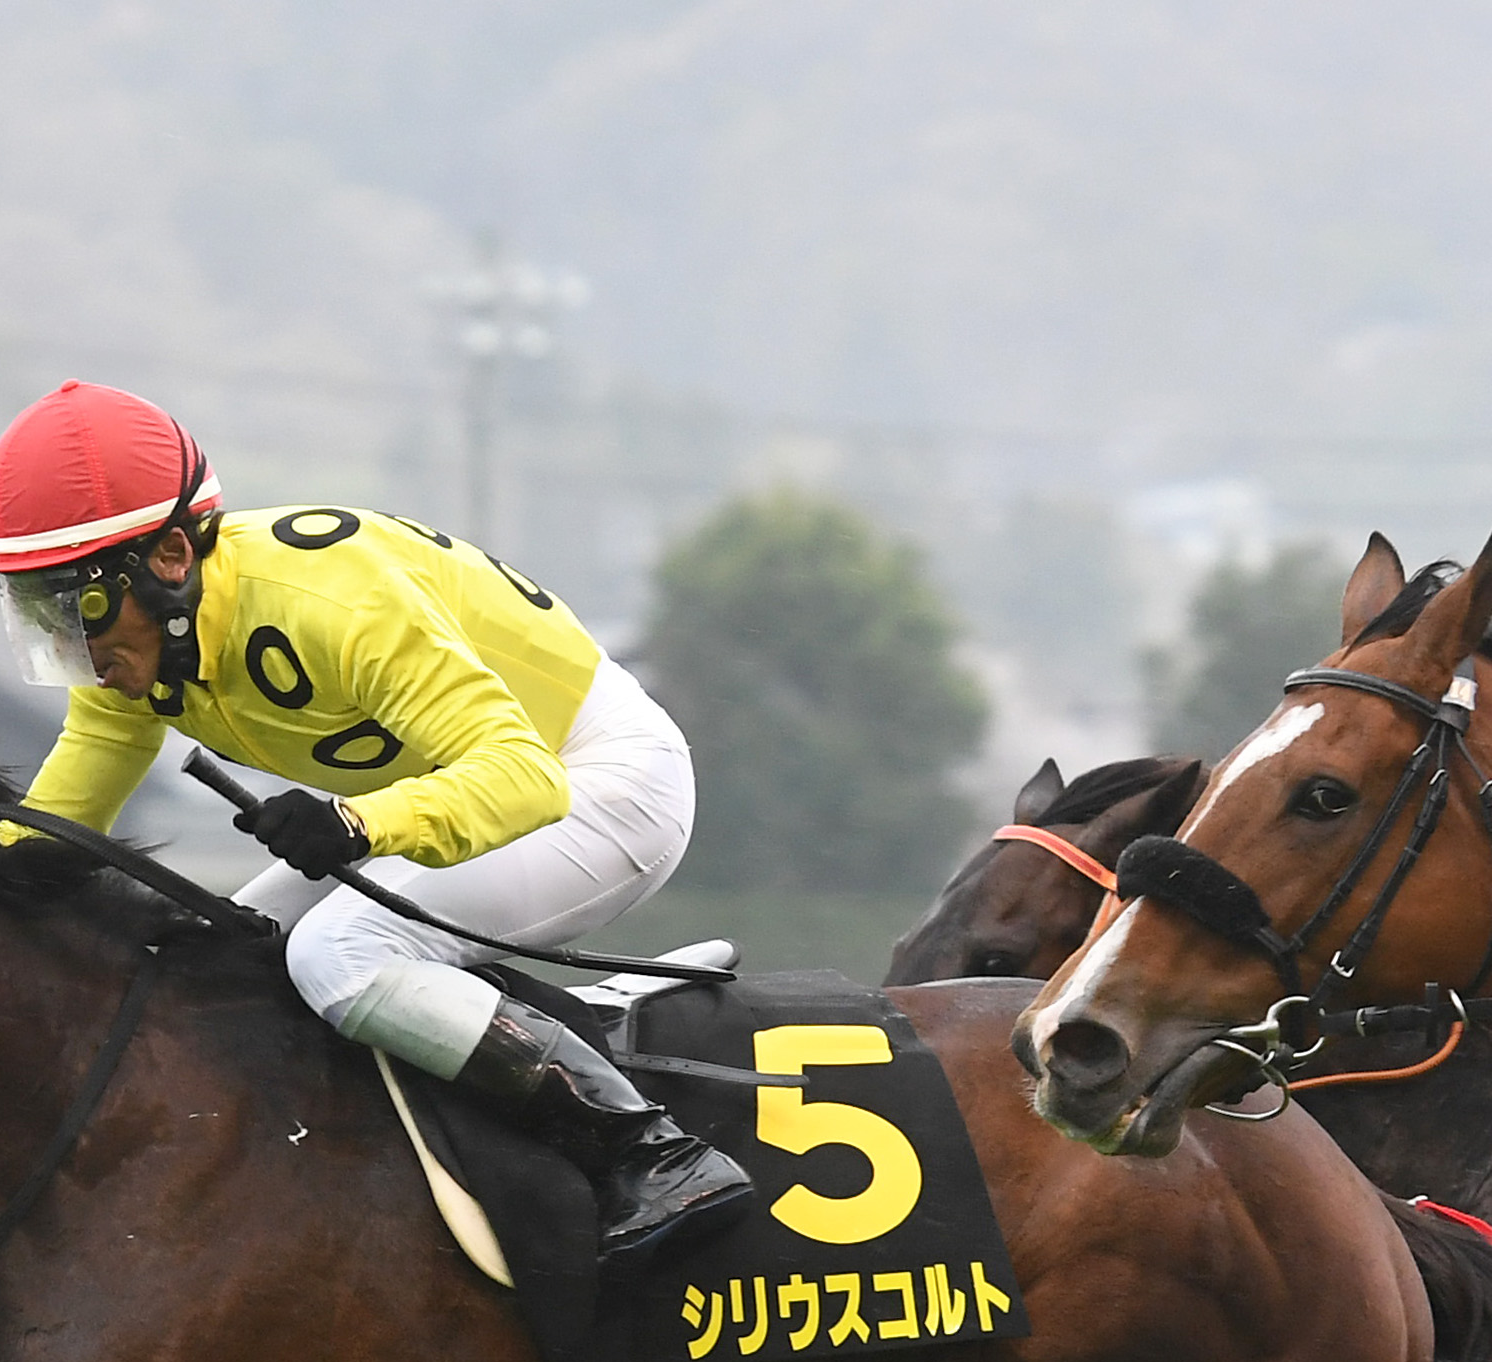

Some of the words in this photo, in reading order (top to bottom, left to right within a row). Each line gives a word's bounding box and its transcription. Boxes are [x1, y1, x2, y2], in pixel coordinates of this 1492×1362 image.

[754, 1025, 921, 1243] 5
[682, 1262, 1009, 1359] シリウスコルト
